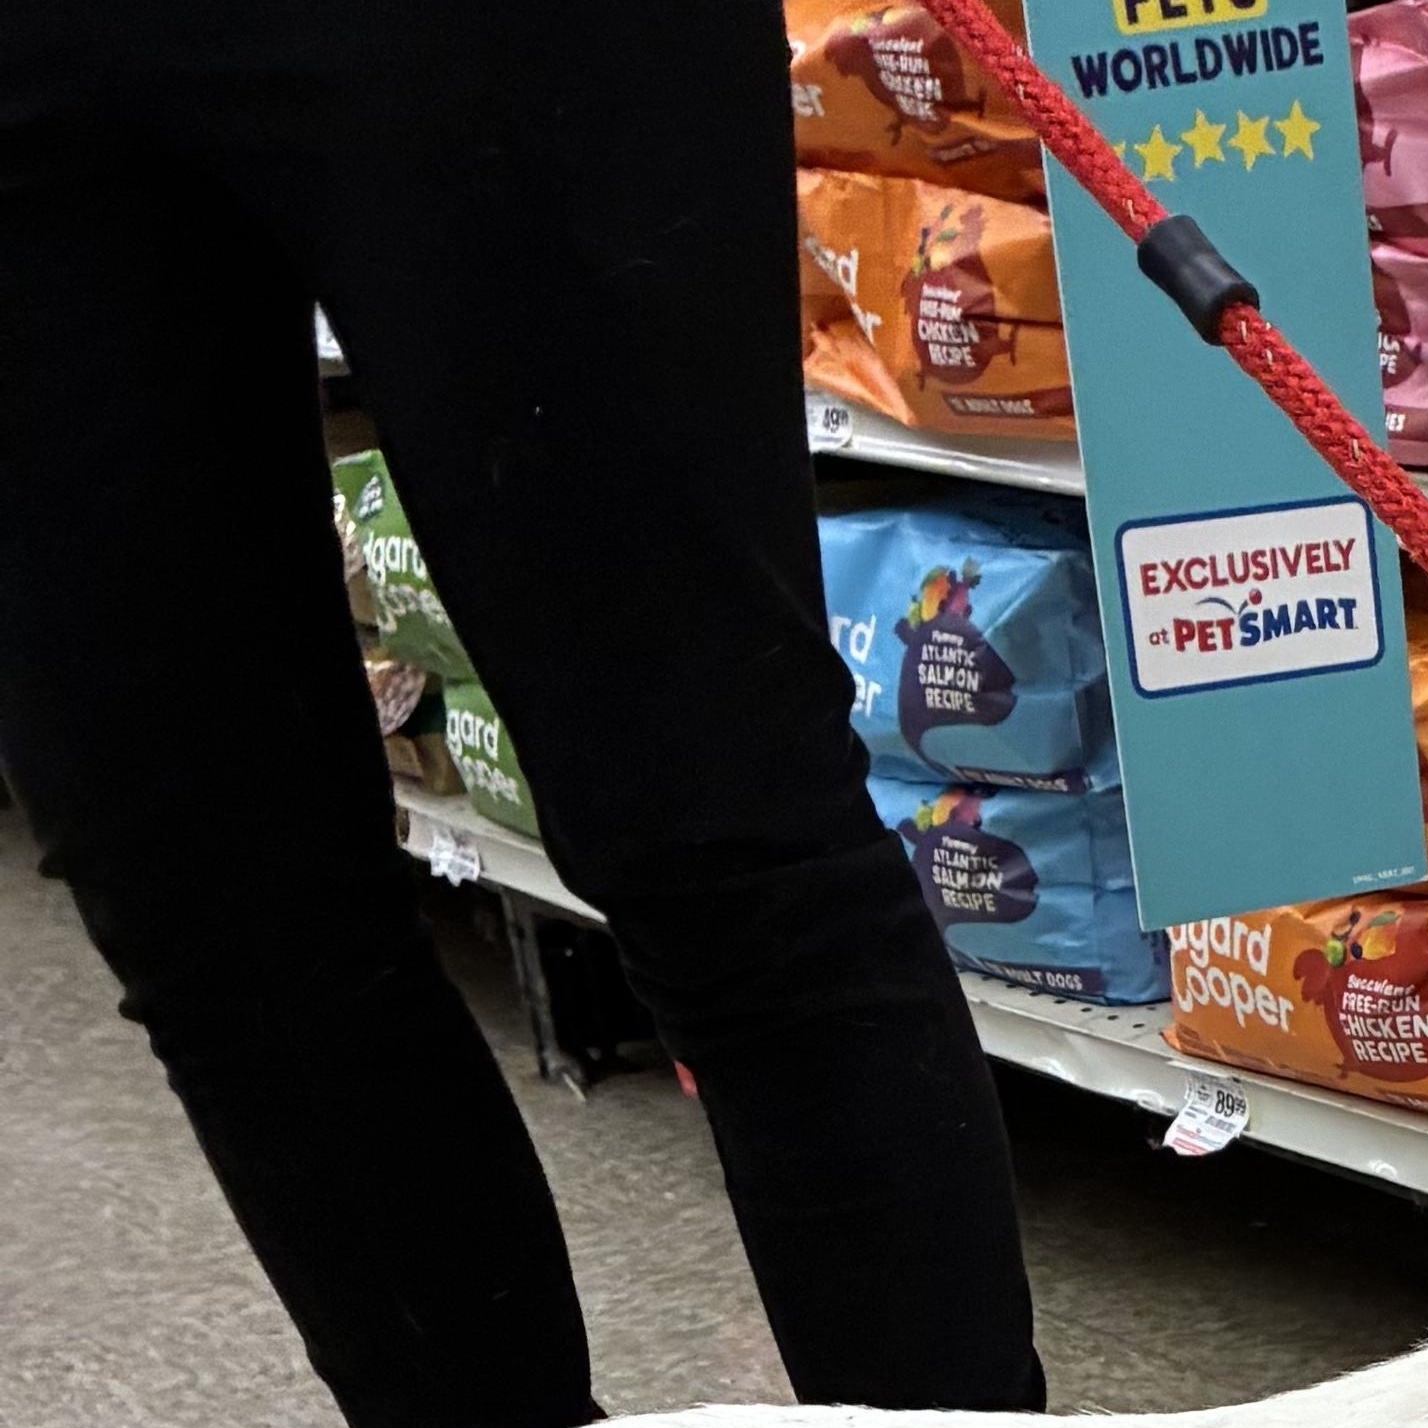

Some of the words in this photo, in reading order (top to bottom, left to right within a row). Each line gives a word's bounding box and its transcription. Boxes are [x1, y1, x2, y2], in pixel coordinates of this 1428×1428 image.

[1071, 21, 1324, 98] WORLDWIDE
[1140, 538, 1356, 596] EXCLUSIVELY
[1149, 627, 1170, 646] at
[1173, 598, 1357, 652] PETSMART
[921, 645, 976, 667] ATLANTIC
[918, 664, 979, 692] SALMON
[925, 688, 975, 713] RECIPE
[933, 848, 998, 870] ATLANTIC
[932, 865, 1003, 891] SALMON
[941, 889, 996, 912] RECIPE
[1045, 970, 1083, 991] DOGS
[1171, 947, 1294, 1033] Cooper
[1342, 992, 1420, 1013] FREE-RUN
[1353, 1042, 1428, 1064] RECIPE
